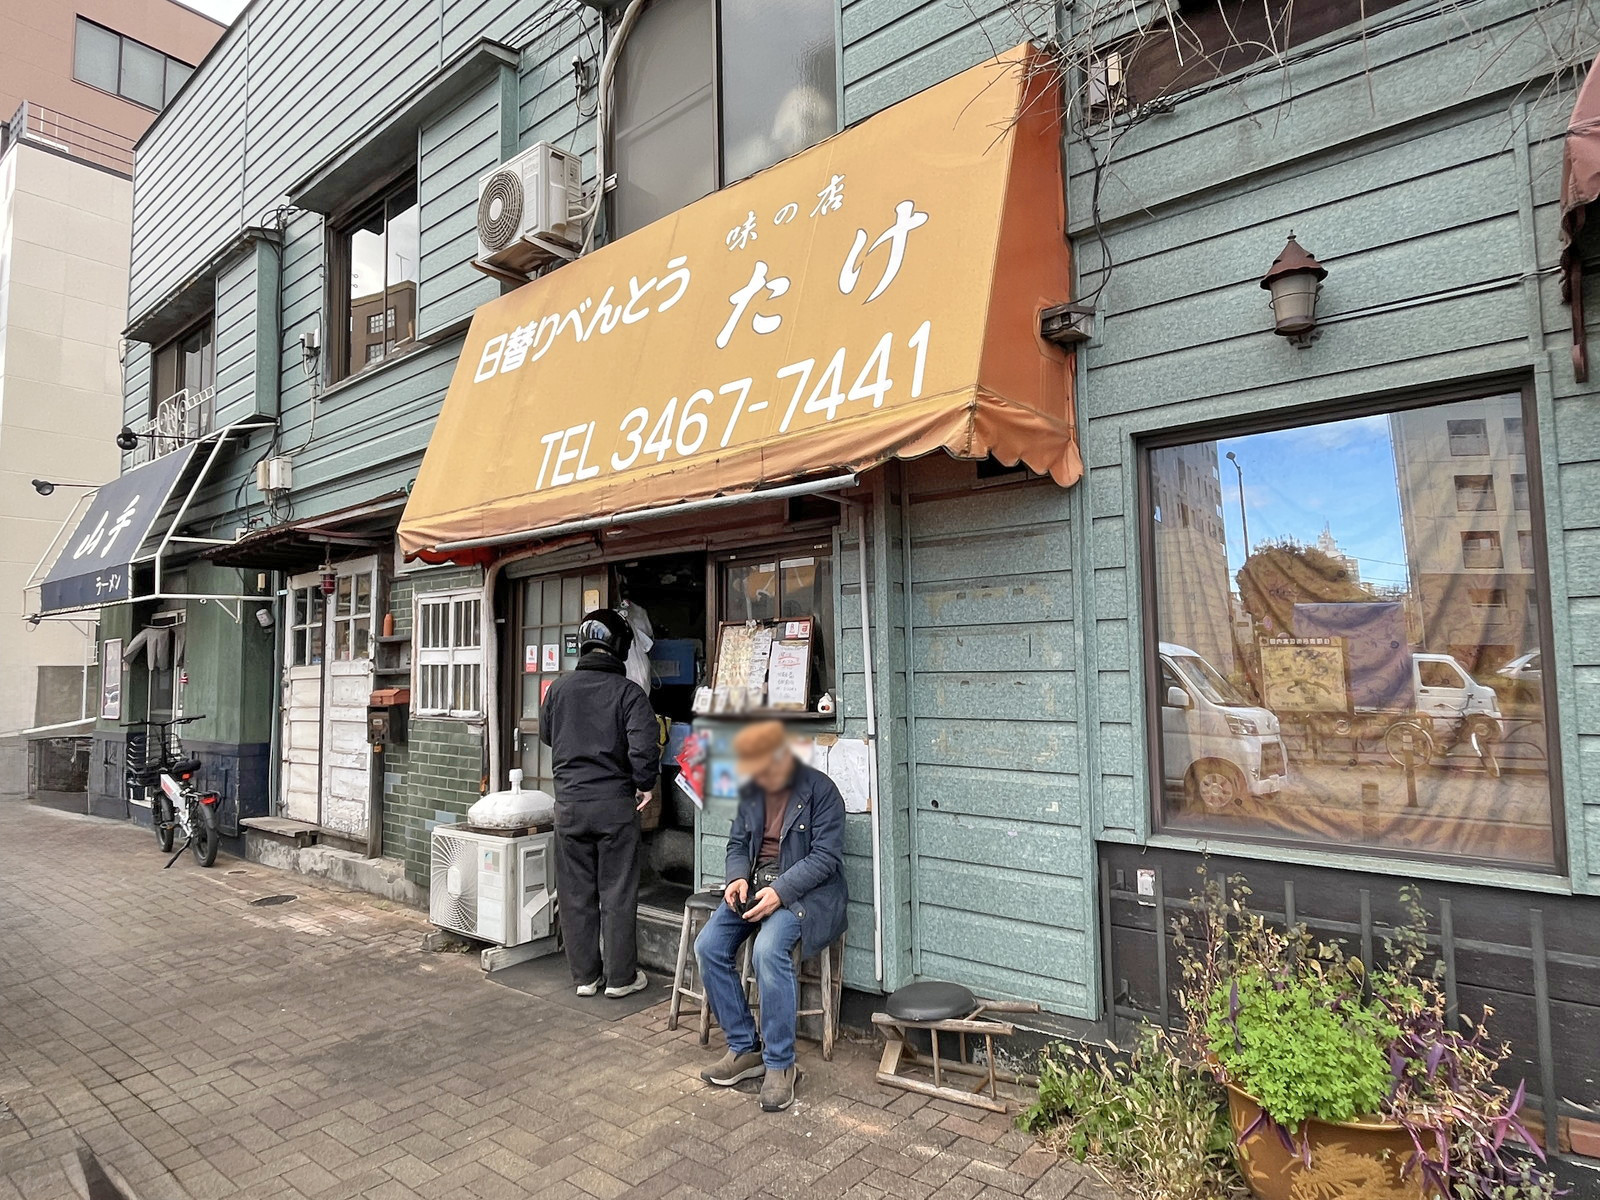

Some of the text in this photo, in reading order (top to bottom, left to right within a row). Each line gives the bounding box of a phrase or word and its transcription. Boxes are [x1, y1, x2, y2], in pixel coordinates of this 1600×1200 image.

[725, 173, 845, 251] 味の店
[473, 255, 691, 384] 日替りべんとう
[715, 200, 930, 350] たけ
[534, 320, 931, 491] TEL 3467-7441
[72, 494, 141, 560] 山手
[95, 573, 122, 596] ラーメン
